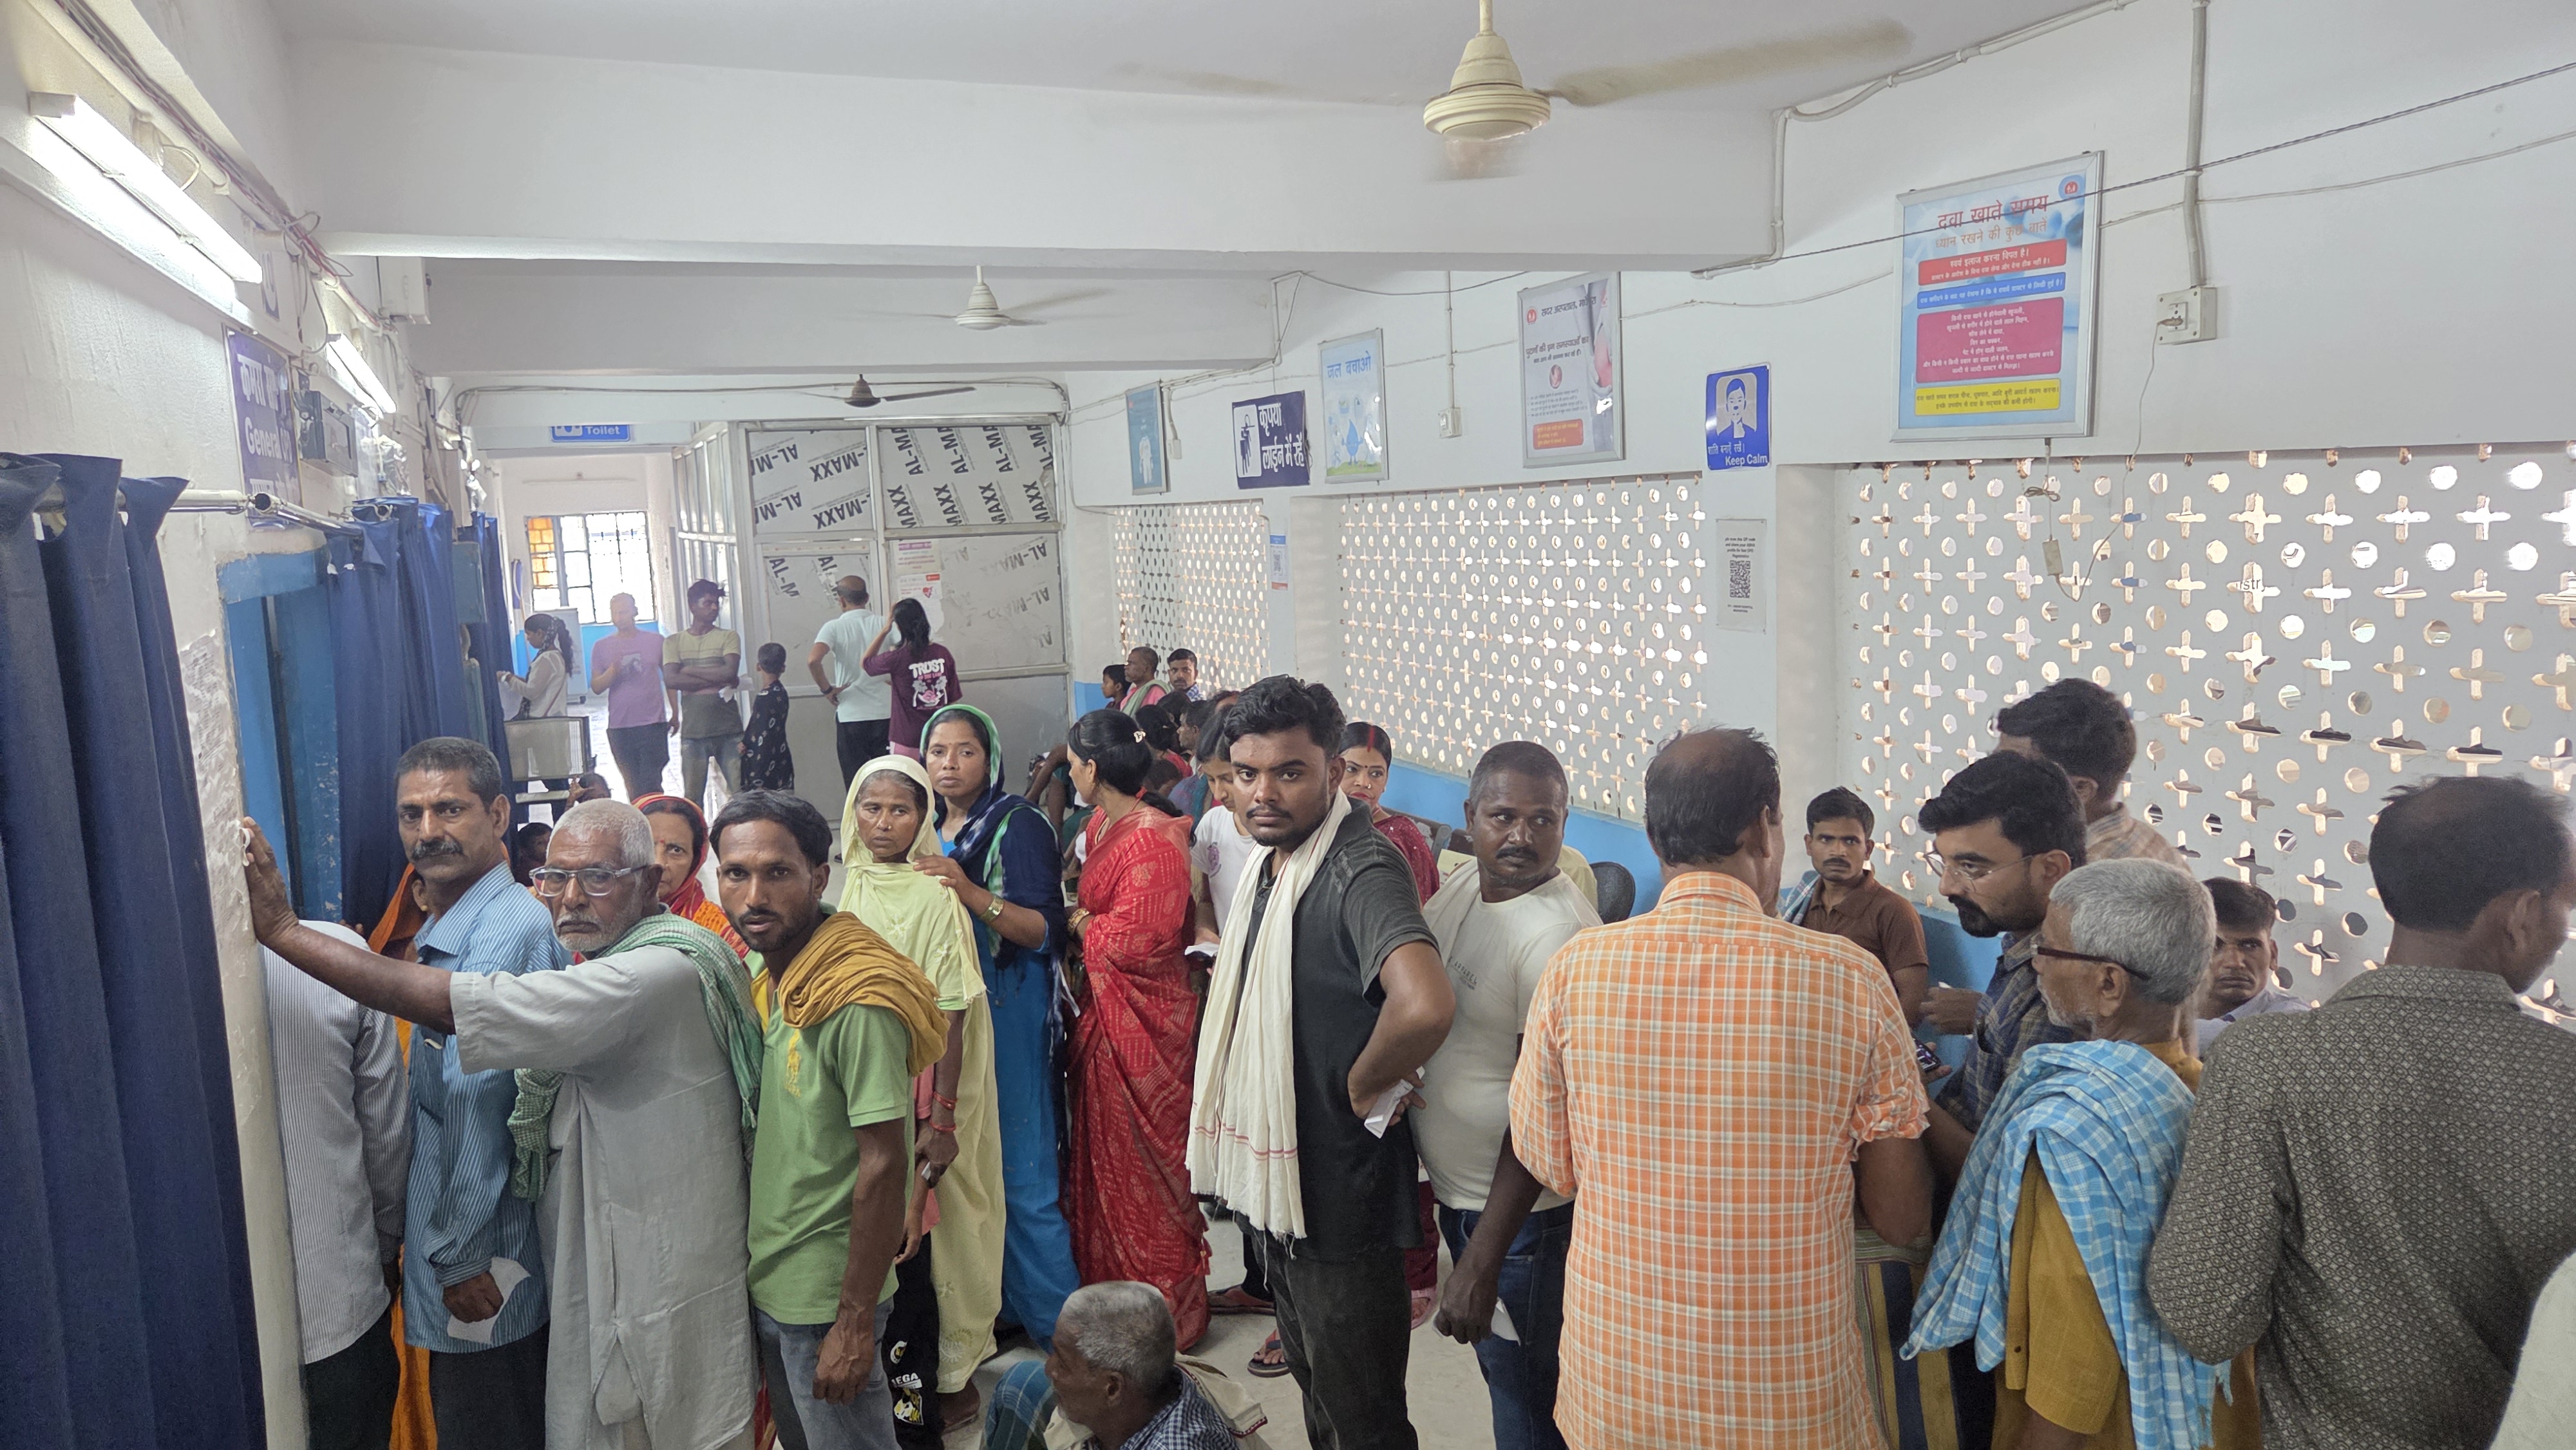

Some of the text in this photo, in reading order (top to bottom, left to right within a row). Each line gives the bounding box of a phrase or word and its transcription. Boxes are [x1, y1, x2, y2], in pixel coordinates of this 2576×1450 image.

[1937, 195, 2049, 230] दवा खाते समय
[1935, 216, 2047, 248] ध्यान रखने की कुछ बातें
[1964, 256, 1981, 267] इलाज
[1984, 254, 2000, 263] करना
[1327, 350, 1371, 379] जल बचाओ
[245, 417, 282, 460] General
[585, 426, 620, 435] Toilet
[1262, 431, 1305, 473] लाईन में रहें
[1725, 453, 1768, 467] Keep Calm
[909, 658, 945, 678] TRUST
